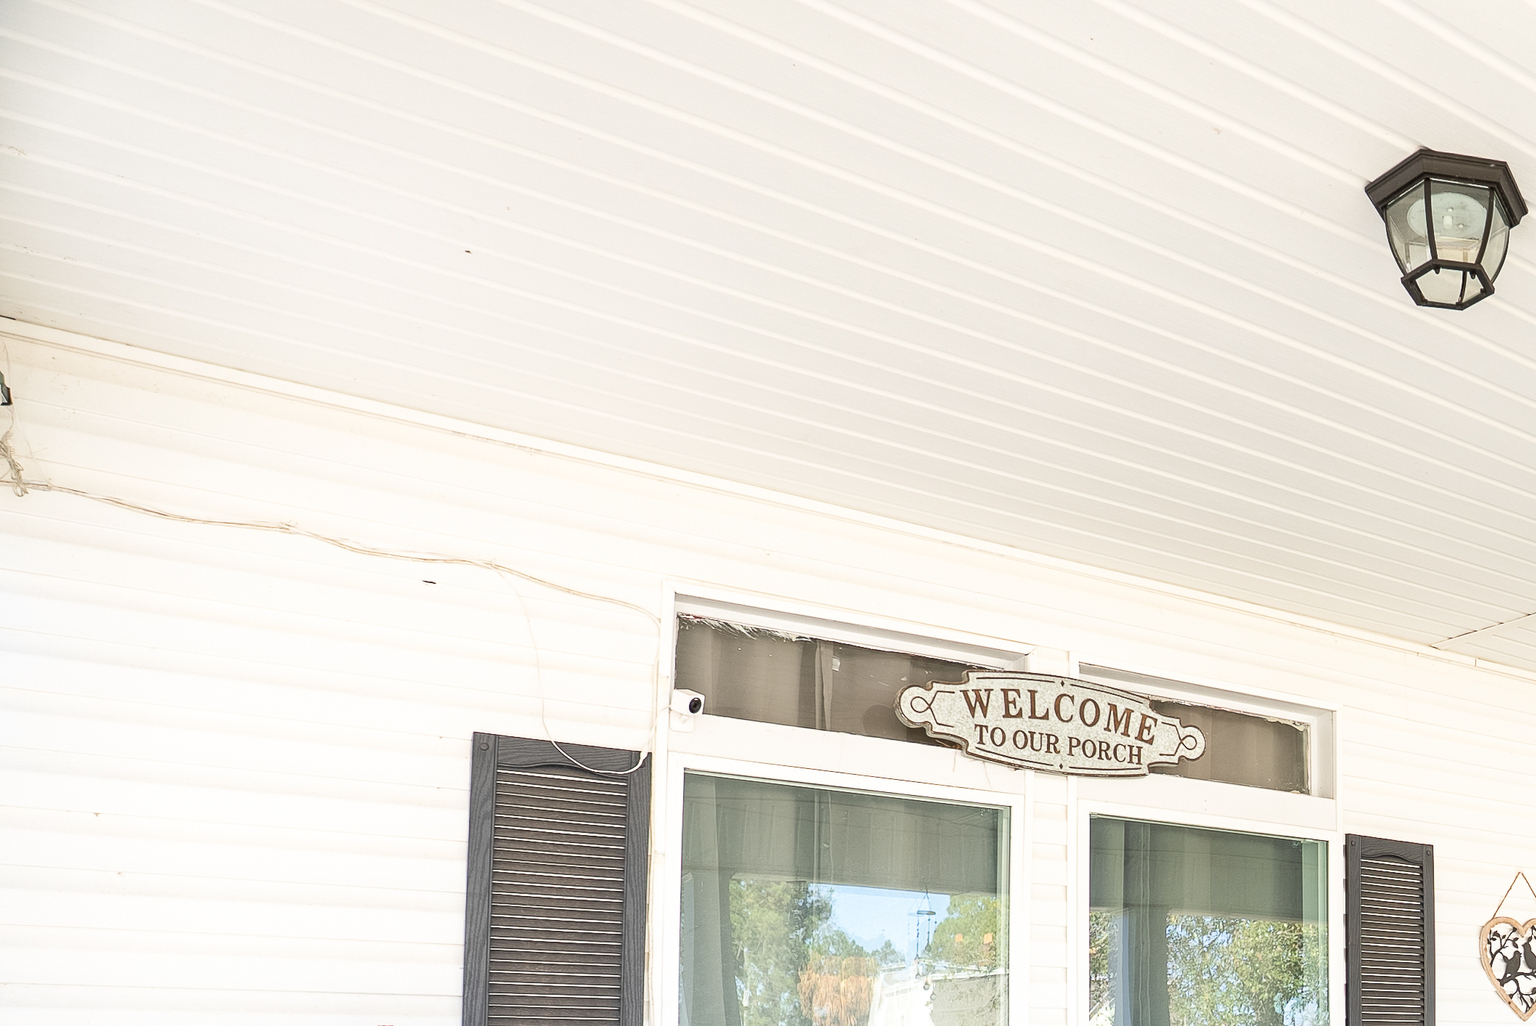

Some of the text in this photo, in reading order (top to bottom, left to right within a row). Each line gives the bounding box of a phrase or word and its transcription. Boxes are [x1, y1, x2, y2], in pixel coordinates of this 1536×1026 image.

[961, 687, 1158, 746] WELCOME
[974, 724, 1143, 766] TO OUR PORCH
